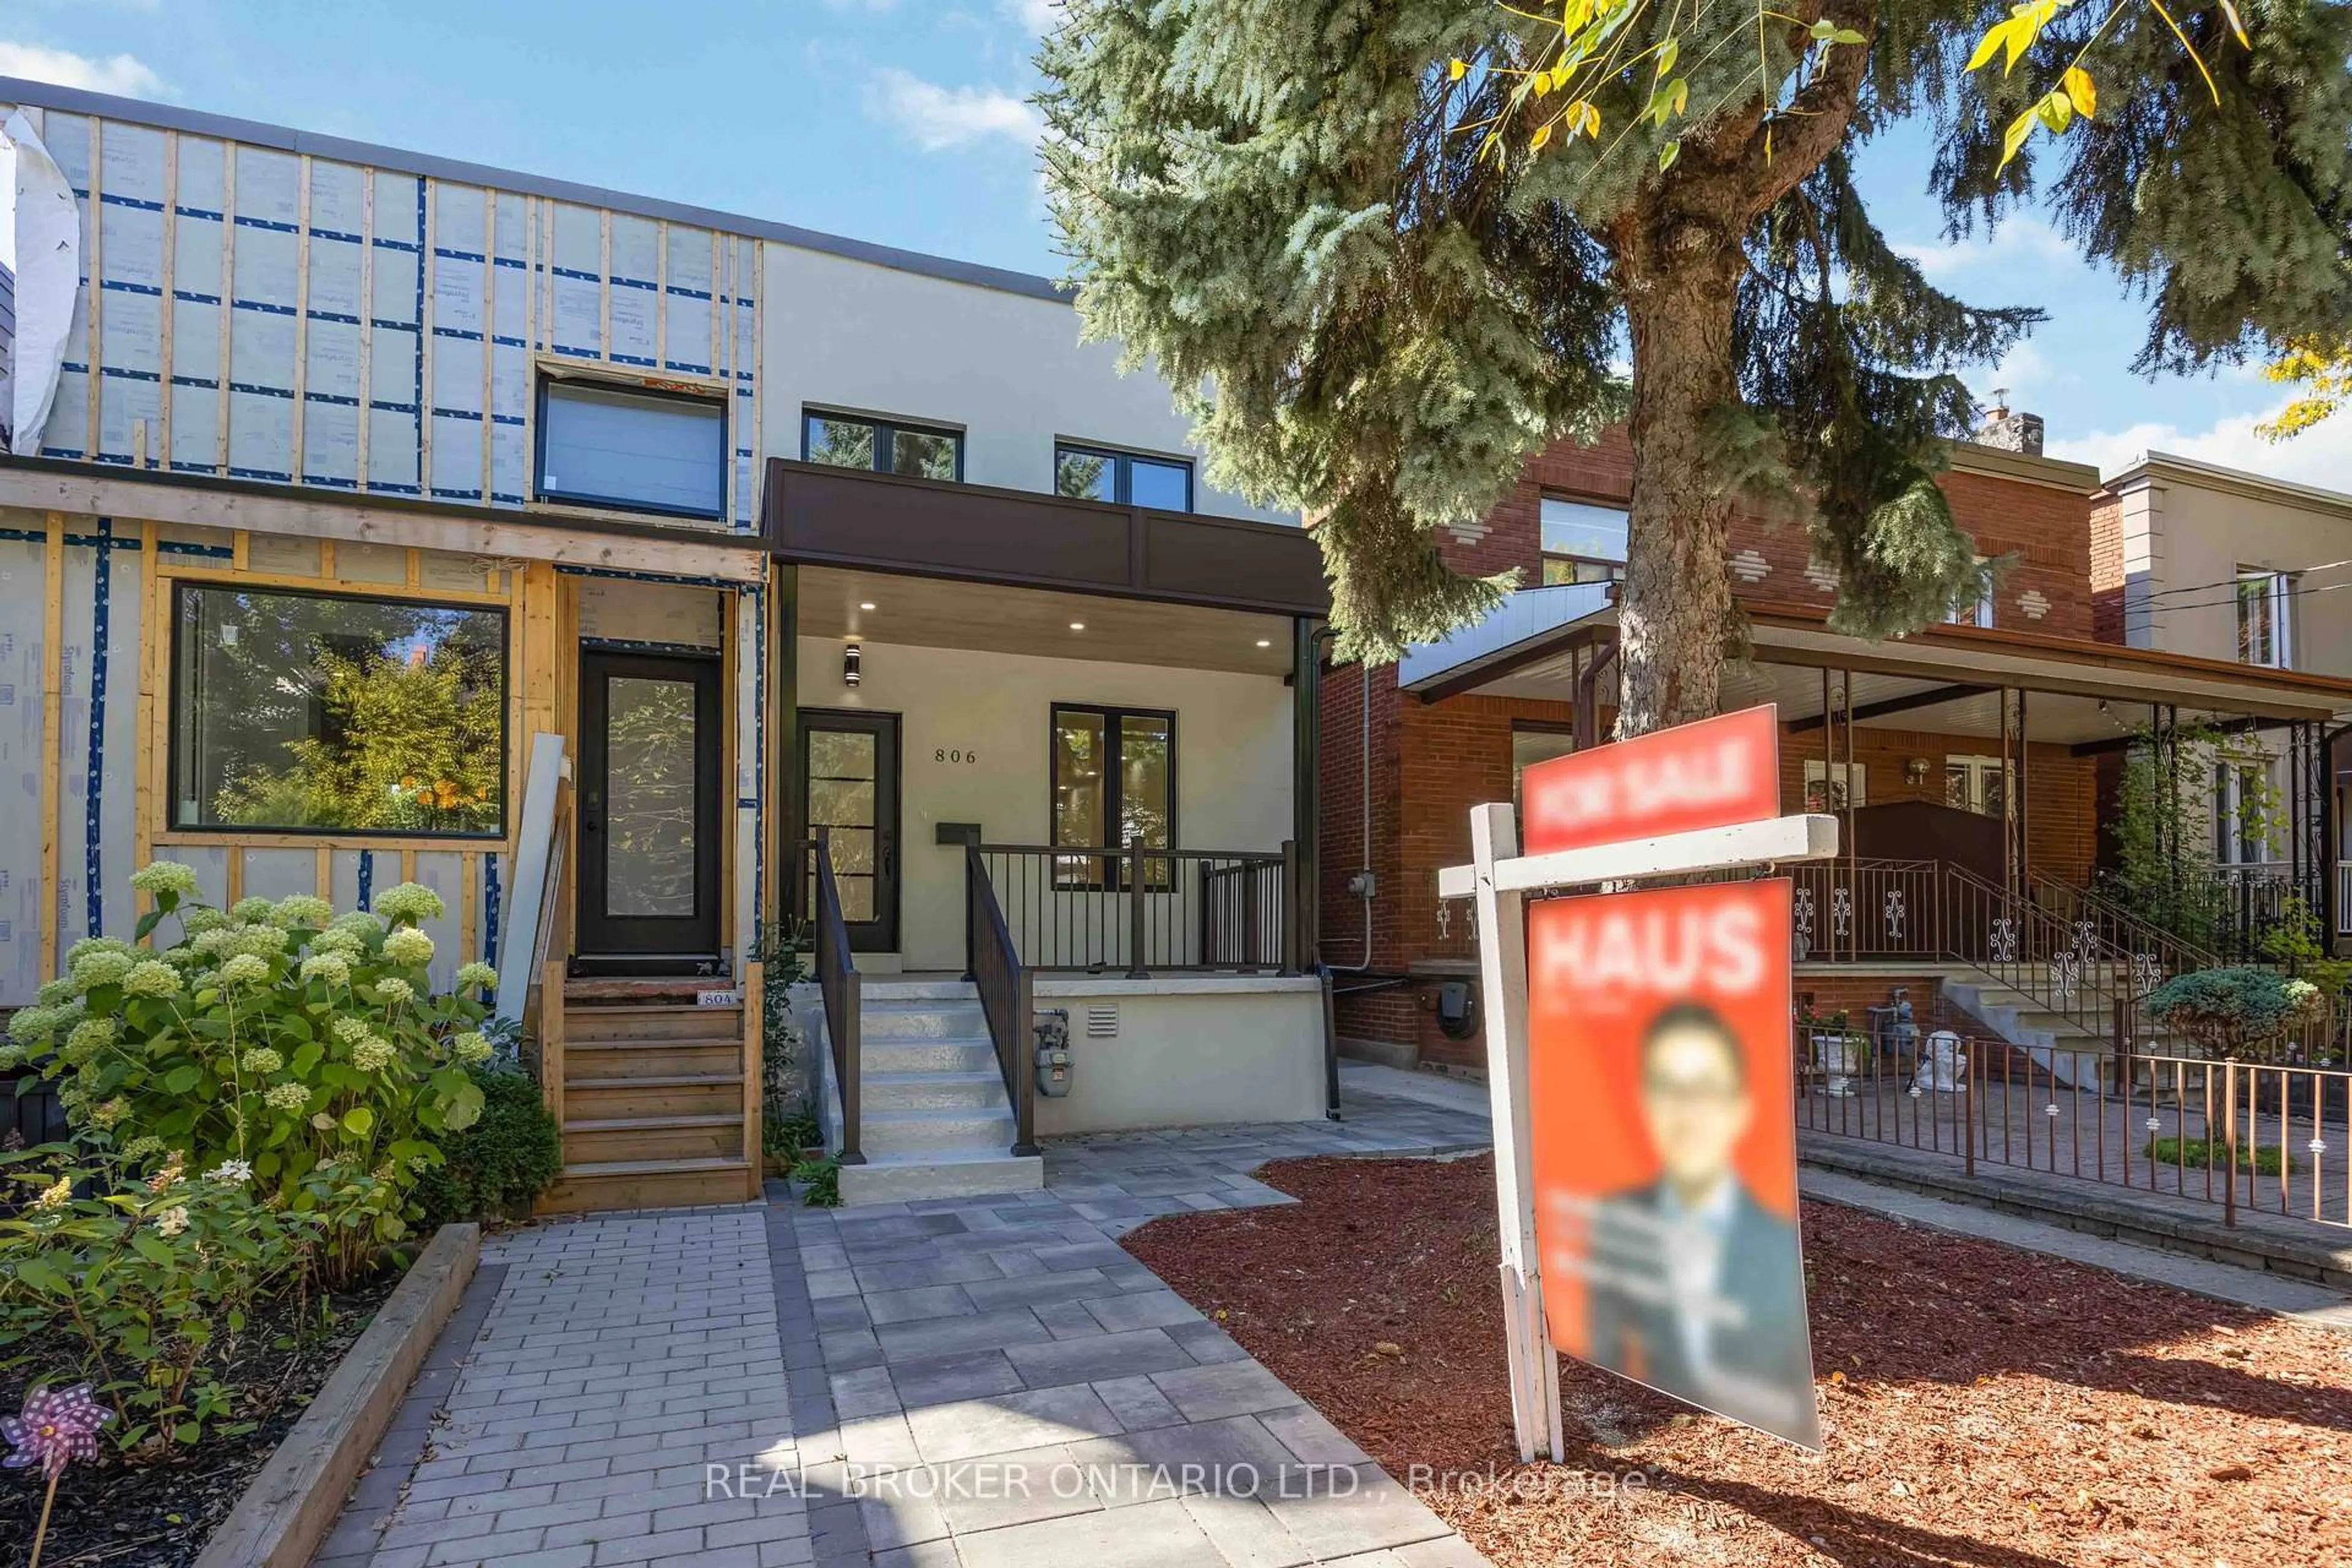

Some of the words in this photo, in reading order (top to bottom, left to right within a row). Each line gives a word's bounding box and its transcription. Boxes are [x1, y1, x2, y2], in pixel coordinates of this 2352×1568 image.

[935, 748, 976, 764] 806
[1541, 901, 1764, 992] HAUS
[706, 994, 731, 1005] 804
